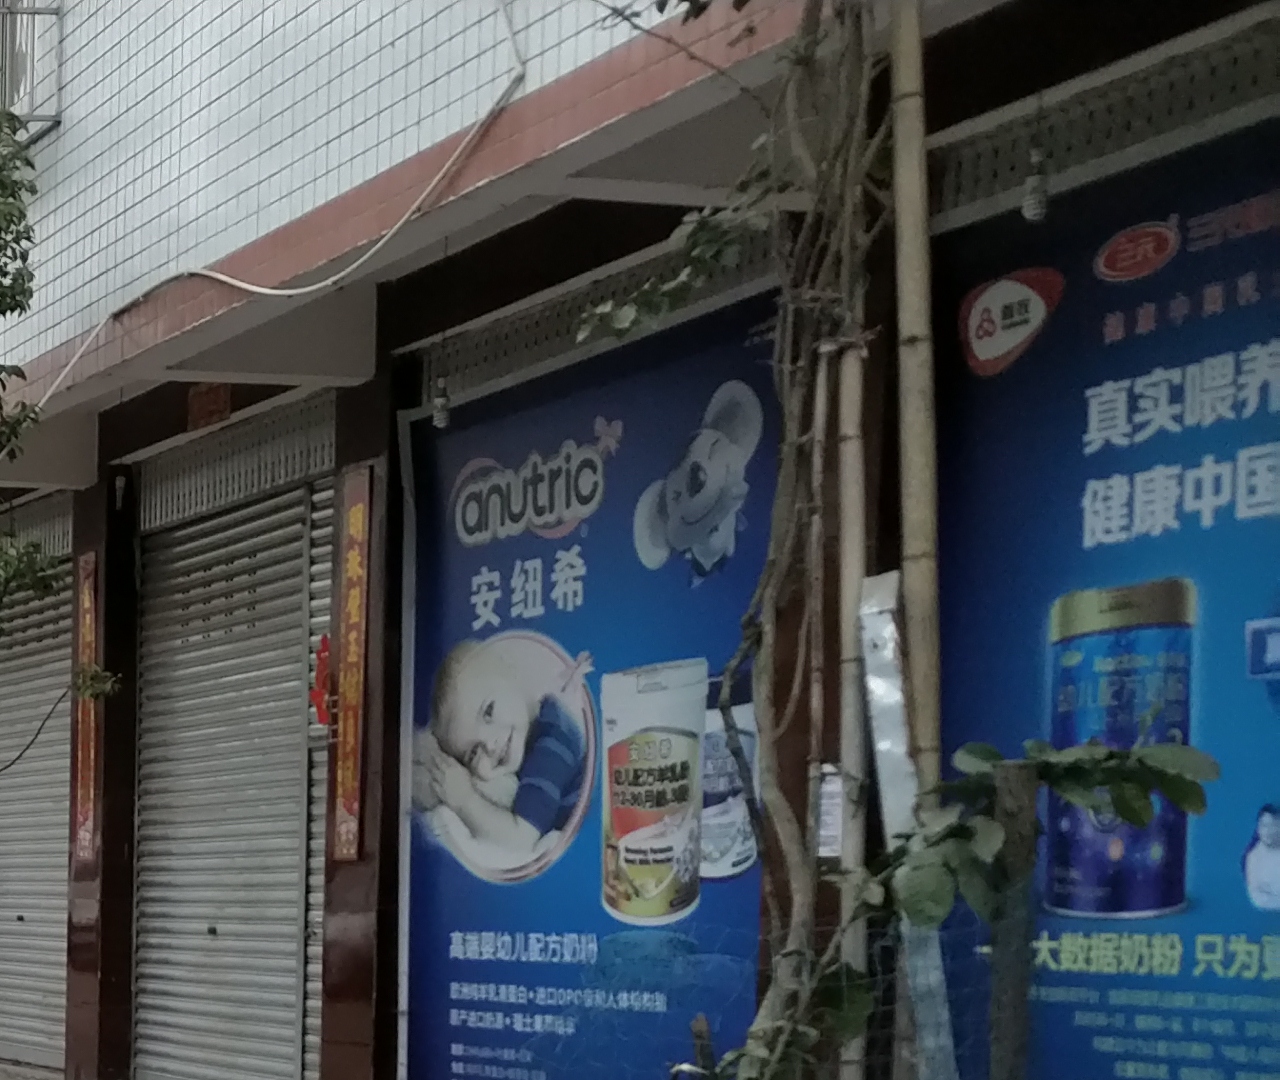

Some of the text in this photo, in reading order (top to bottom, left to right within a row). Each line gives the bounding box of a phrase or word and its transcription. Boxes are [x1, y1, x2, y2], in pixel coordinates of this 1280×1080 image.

[460, 455, 600, 537] anutric
[470, 545, 589, 631] 安纽希
